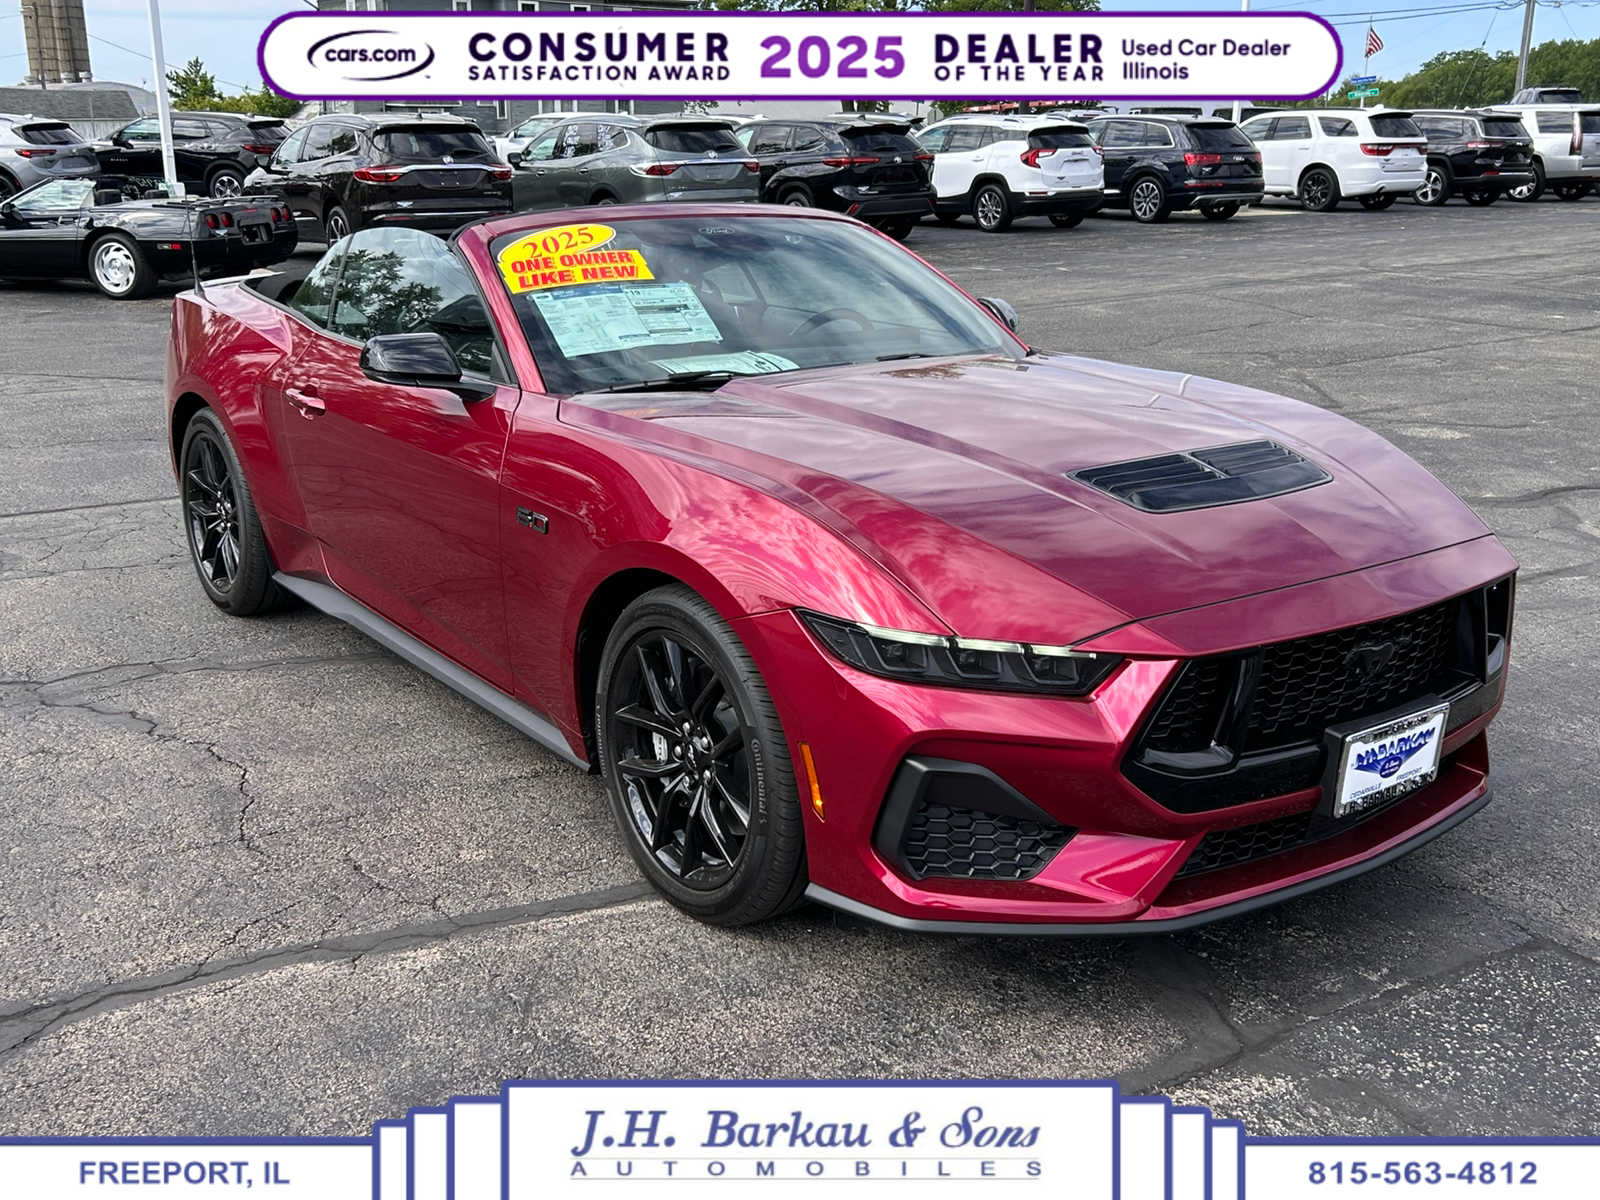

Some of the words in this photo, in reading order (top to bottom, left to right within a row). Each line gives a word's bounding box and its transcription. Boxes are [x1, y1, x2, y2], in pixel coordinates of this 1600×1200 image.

[523, 227, 594, 258] 2025
[511, 256, 554, 273] ONE
[560, 251, 634, 267] OWNER
[518, 269, 575, 289] LIKE
[581, 265, 638, 281] NEW
